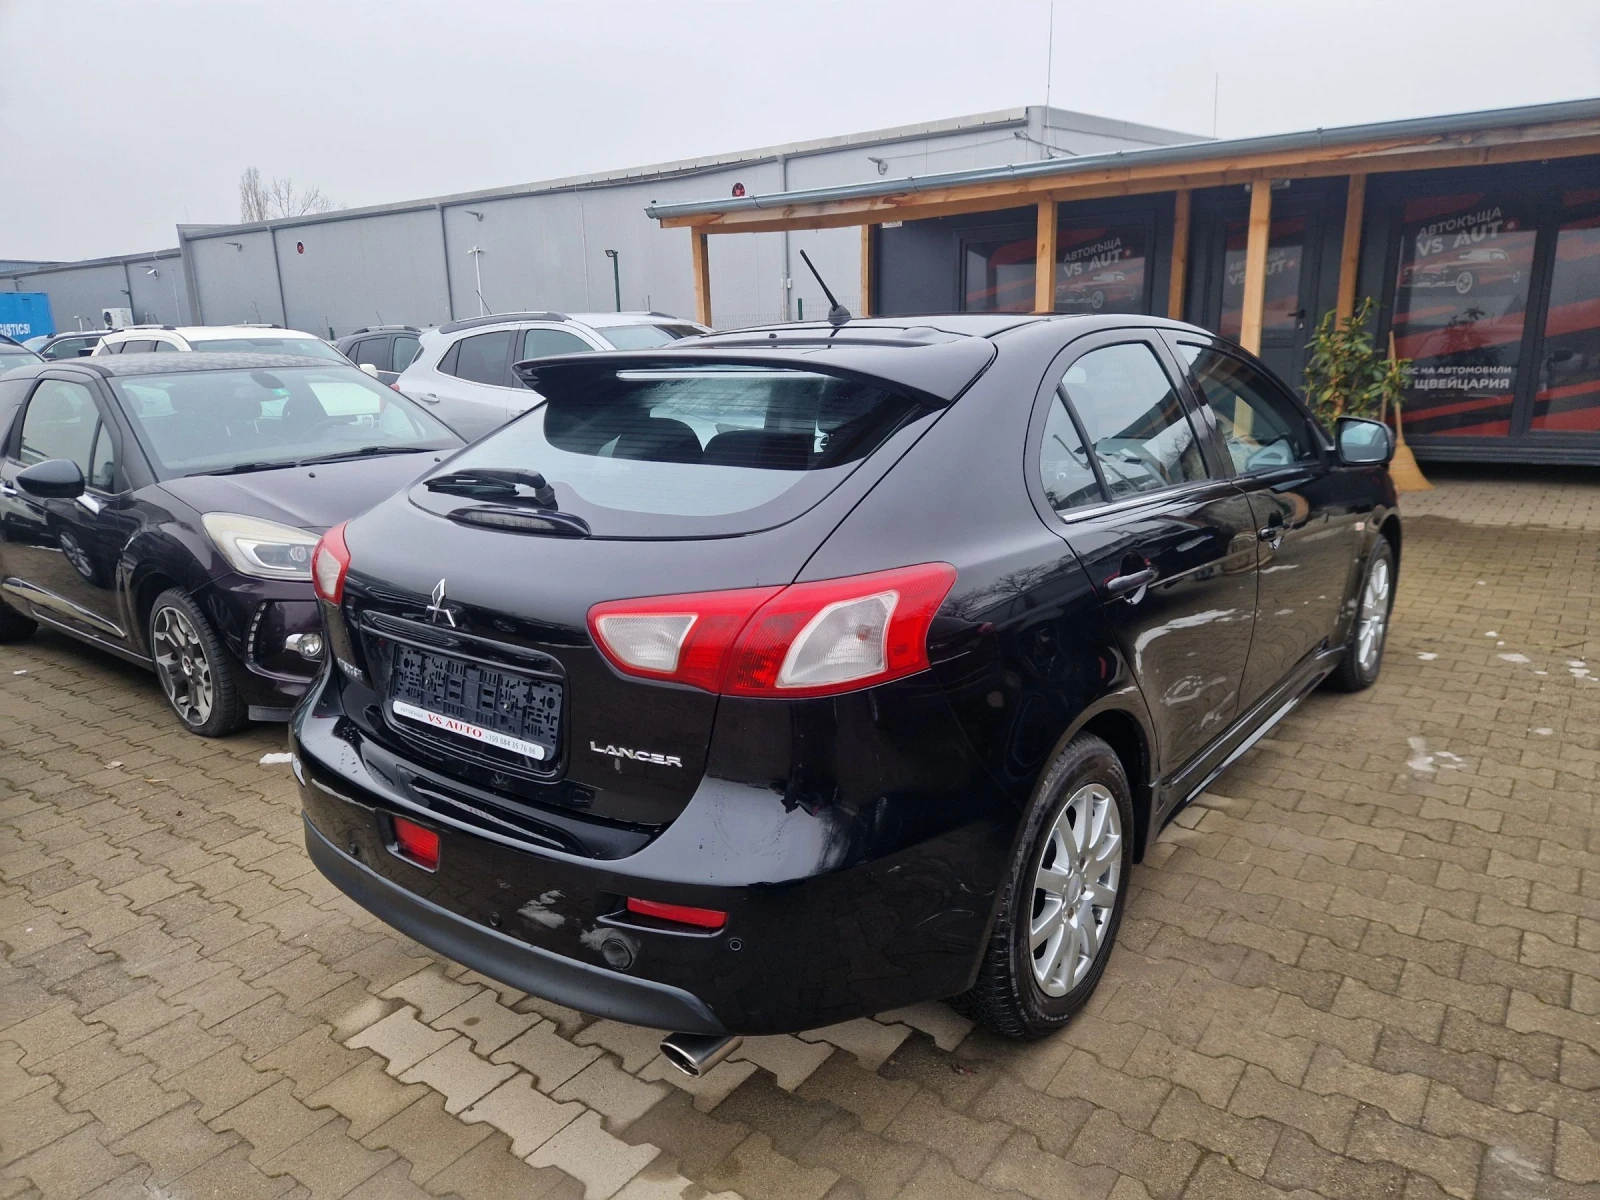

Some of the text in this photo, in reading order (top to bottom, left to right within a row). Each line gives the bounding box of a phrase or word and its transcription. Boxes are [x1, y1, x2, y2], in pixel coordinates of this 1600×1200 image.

[1417, 207, 1502, 240] АВТОКЪЩА
[1064, 237, 1121, 263] АВТОКЪЩА
[1416, 238, 1444, 257] VS
[1063, 263, 1083, 277] VS
[1437, 365, 1512, 375] АВТОМОБИЛИ
[1414, 376, 1510, 391] ЩВЕЙЦАРИЯ
[427, 714, 442, 725] VS
[446, 720, 482, 738] AUTO
[590, 741, 683, 768] LANCER
